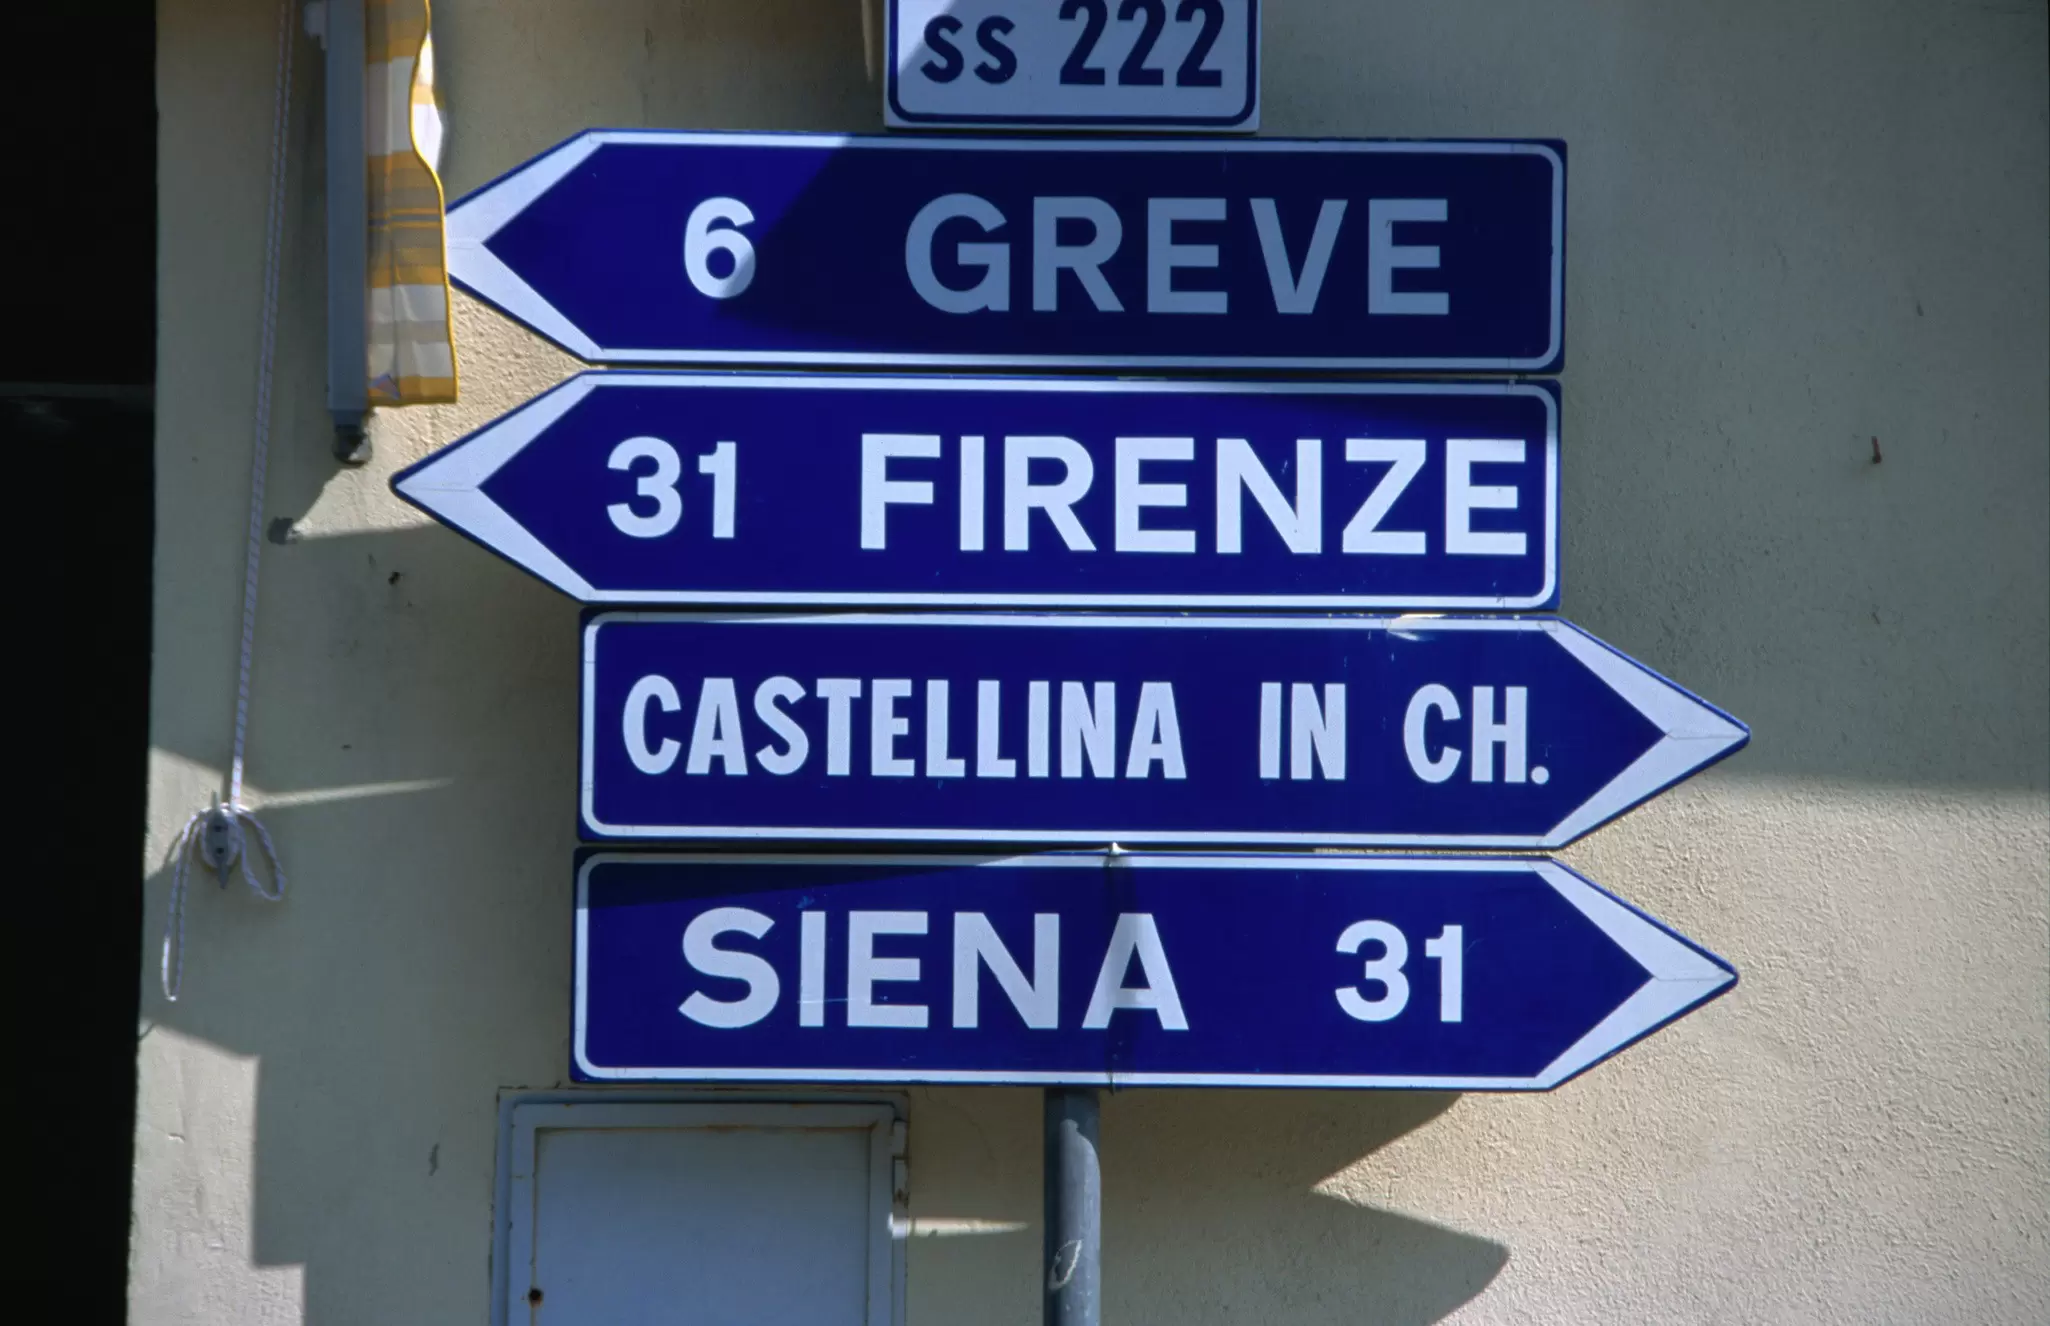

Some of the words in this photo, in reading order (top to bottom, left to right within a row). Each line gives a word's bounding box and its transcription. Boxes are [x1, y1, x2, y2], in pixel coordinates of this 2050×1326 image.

[1058, 0, 1225, 88] 222
[684, 197, 755, 299] 6
[905, 193, 1450, 316] GREVE
[607, 436, 738, 540] 31
[860, 433, 1528, 556] FIRENZE
[622, 674, 1187, 779] CASTELLINA
[1259, 681, 1346, 782] IN
[1403, 683, 1550, 786] CH.
[678, 906, 1190, 1031] SIENA
[1334, 919, 1463, 1023] 31
